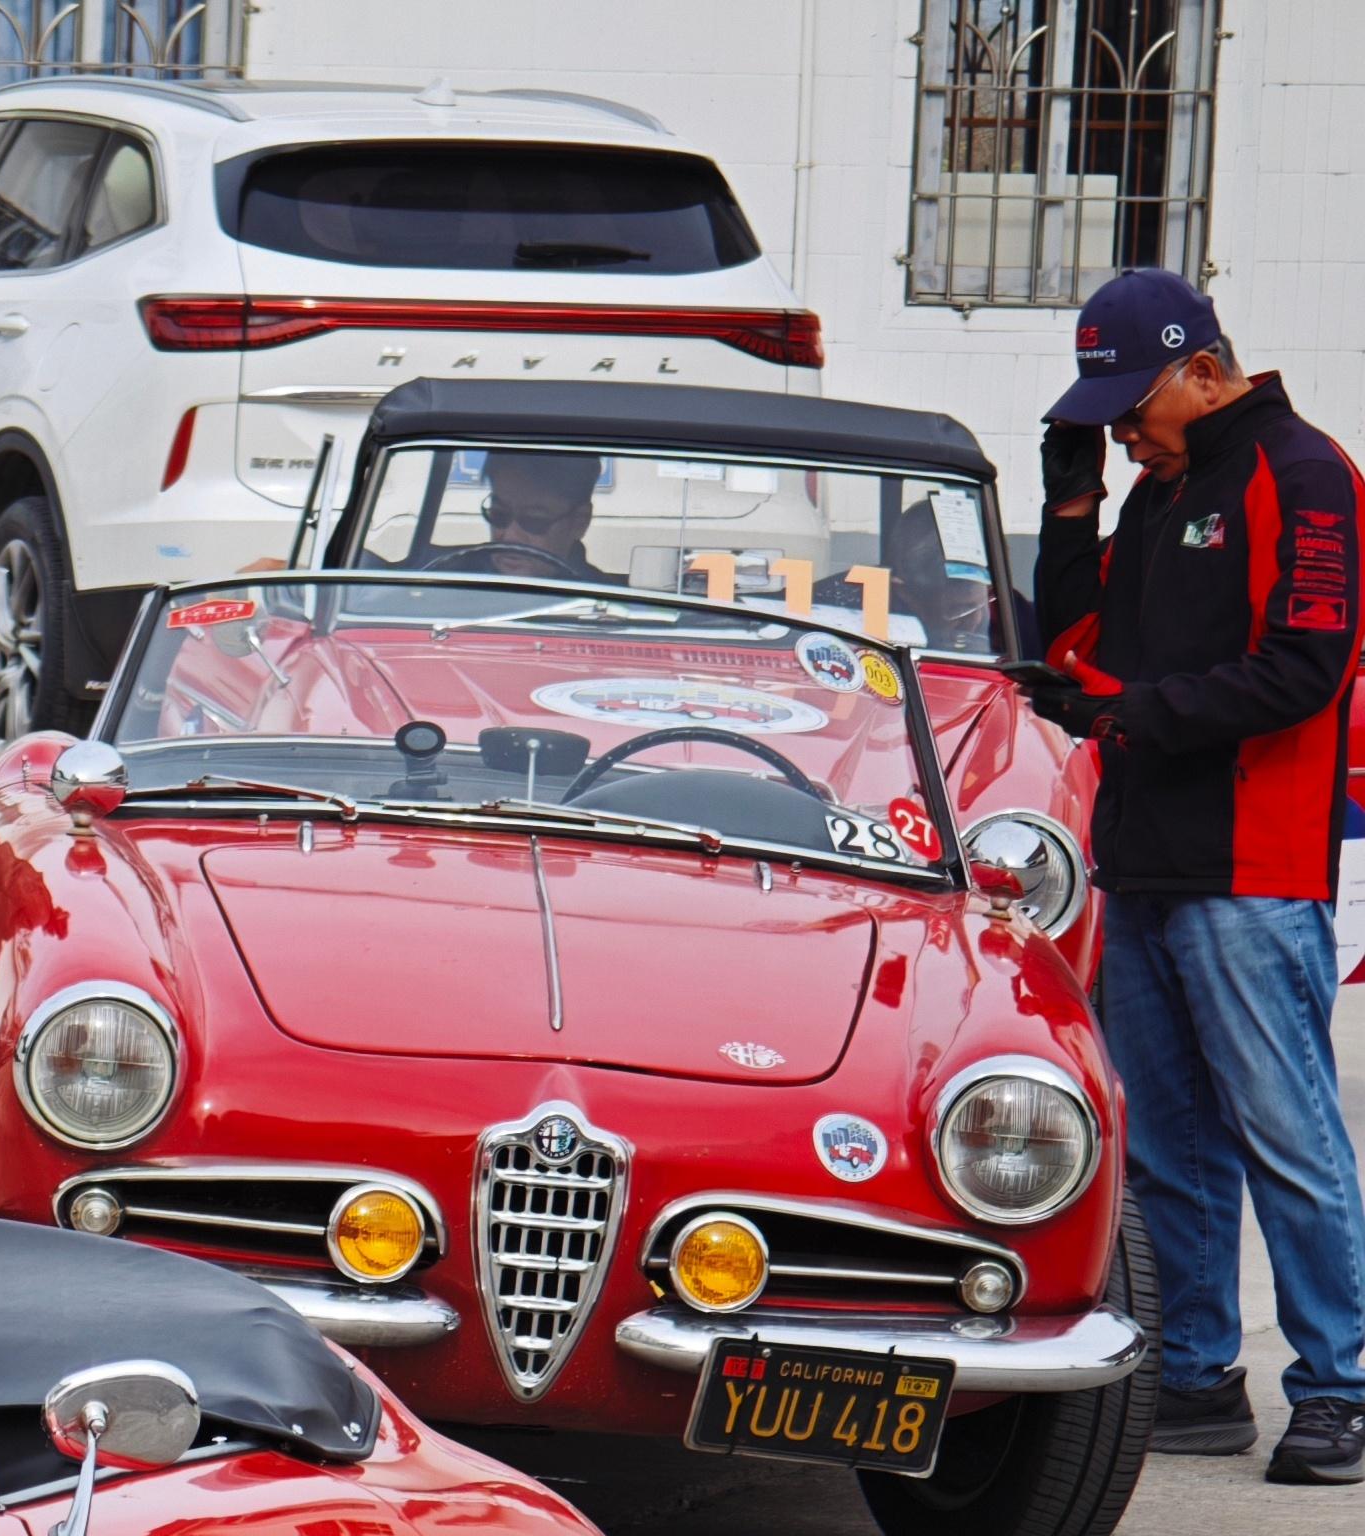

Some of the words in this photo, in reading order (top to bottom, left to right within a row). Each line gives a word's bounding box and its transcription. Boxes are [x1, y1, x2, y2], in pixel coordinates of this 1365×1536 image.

[376, 346, 679, 374] HAVAL
[830, 817, 901, 860] 28
[895, 808, 931, 847] 27
[779, 1360, 884, 1387] CALIFORNIA
[725, 1381, 824, 1440] YUU
[832, 1395, 927, 1454] 418
